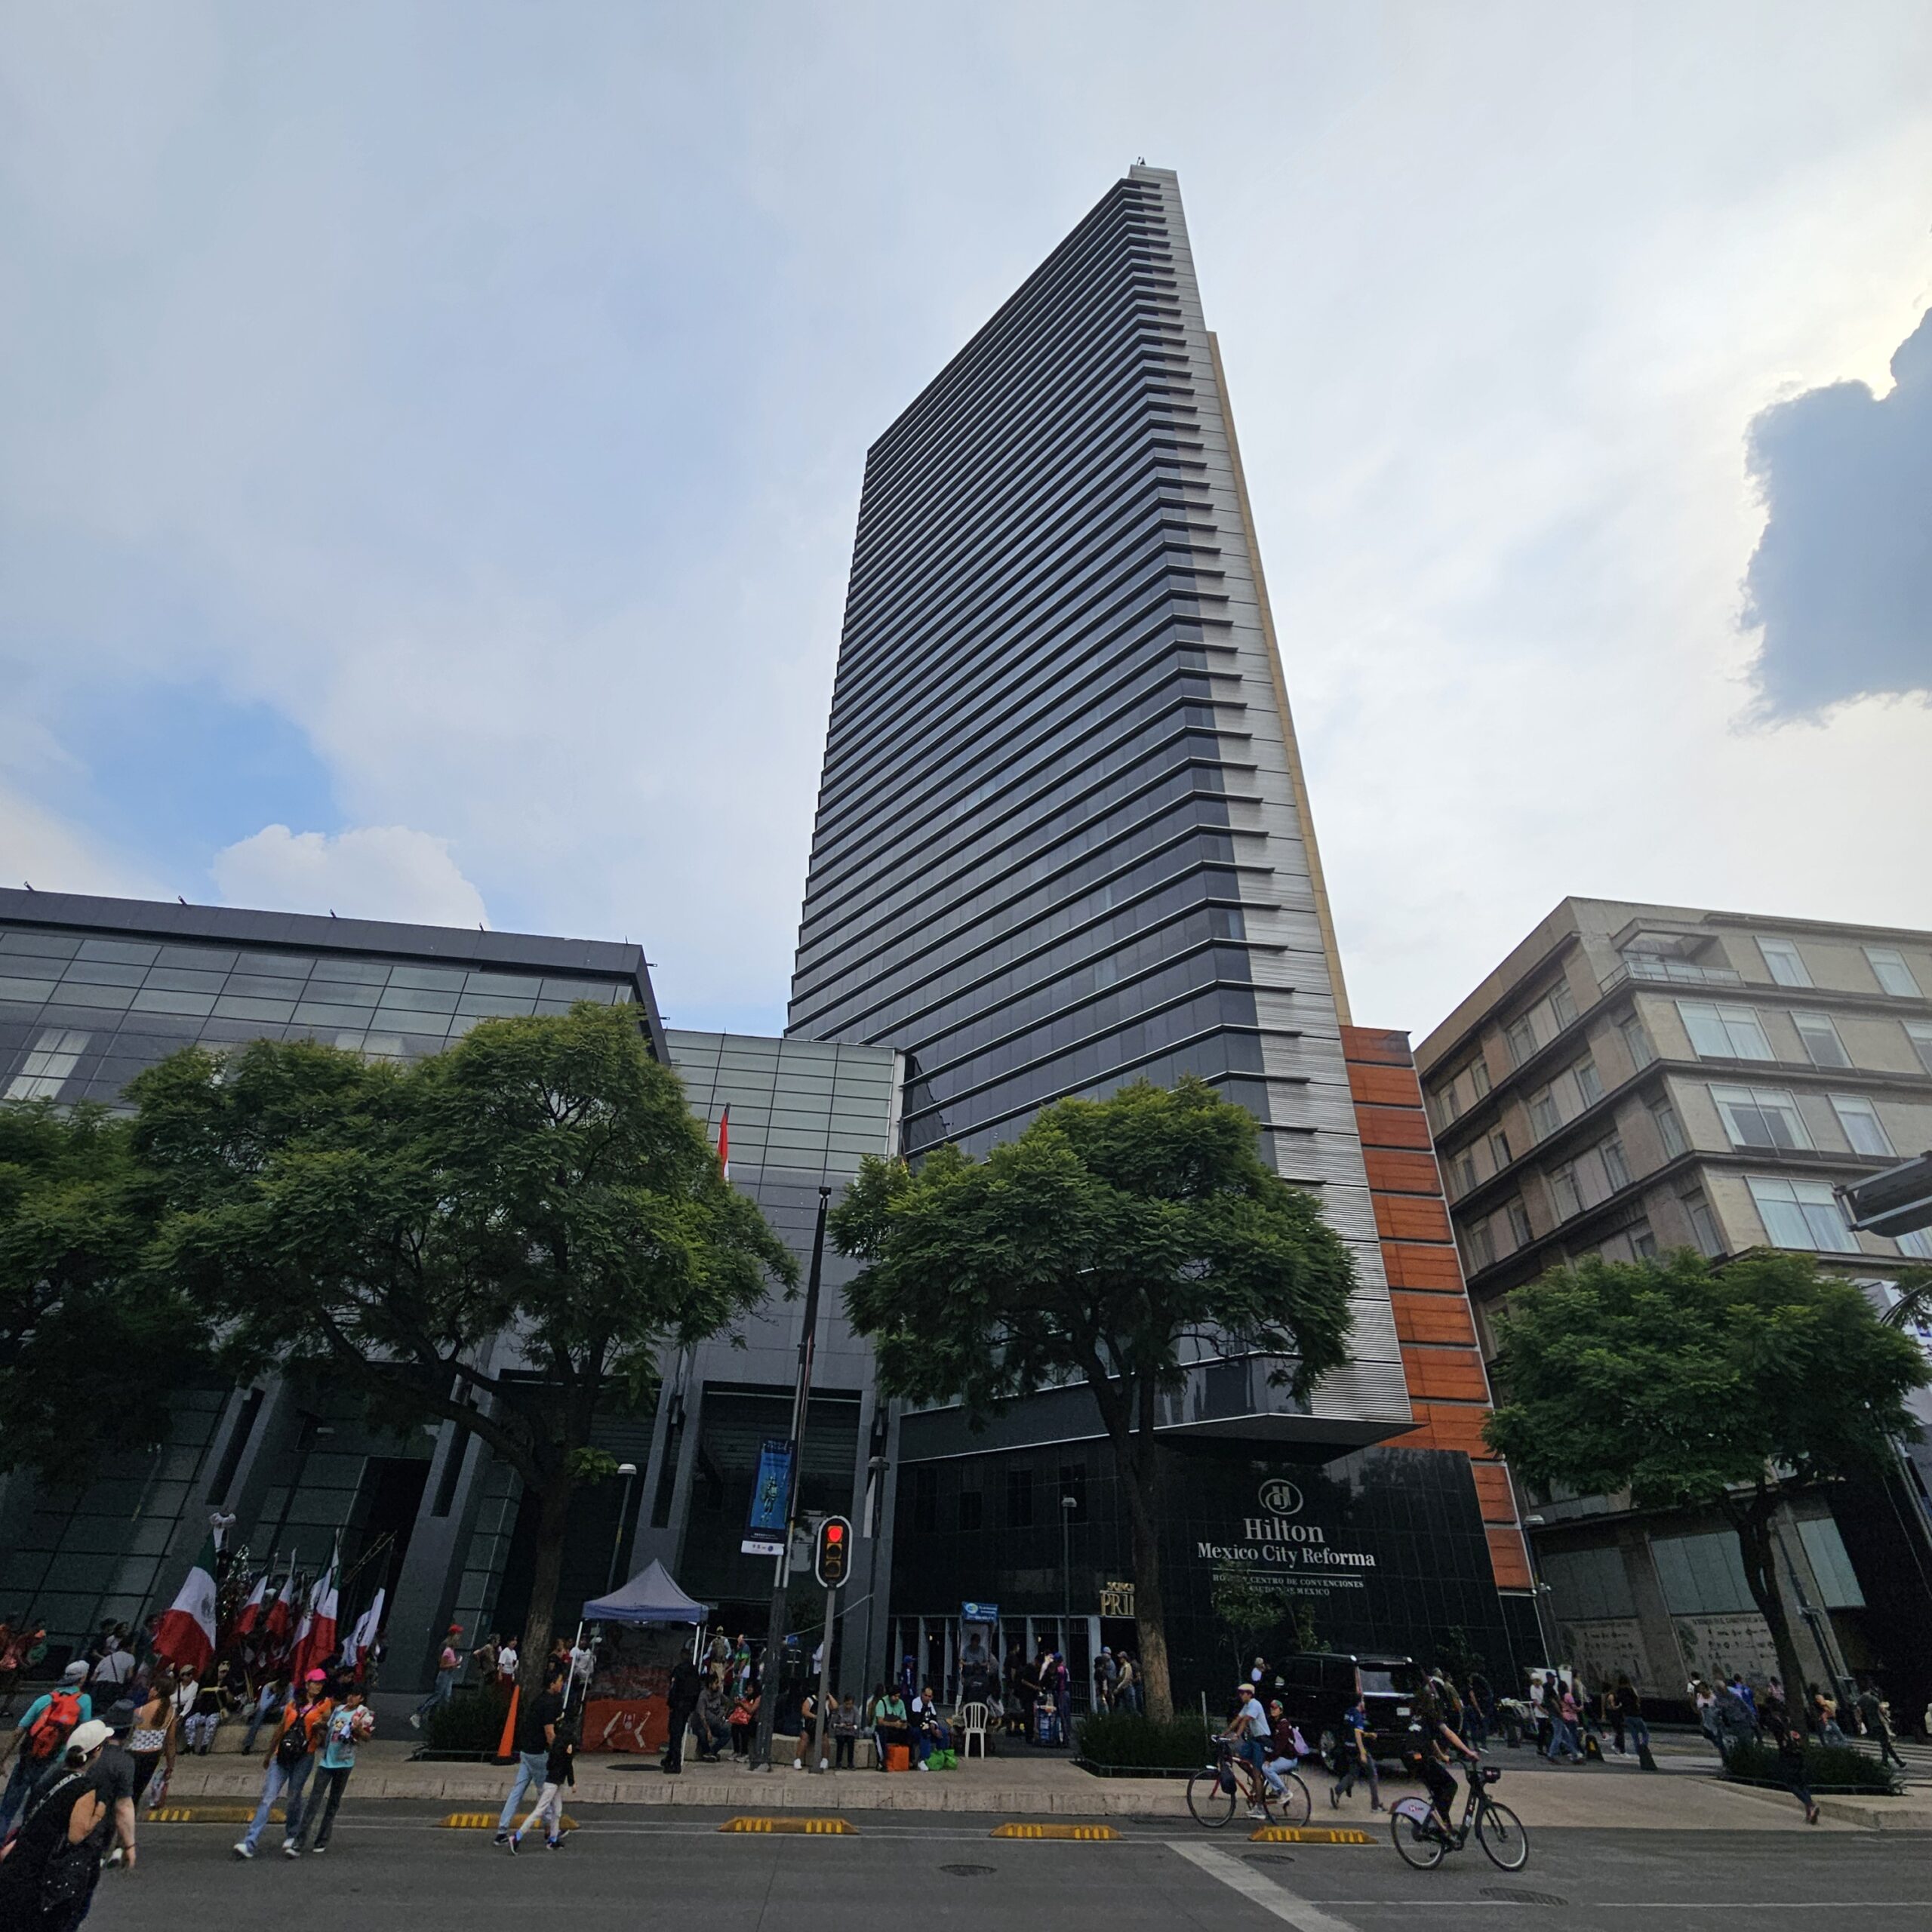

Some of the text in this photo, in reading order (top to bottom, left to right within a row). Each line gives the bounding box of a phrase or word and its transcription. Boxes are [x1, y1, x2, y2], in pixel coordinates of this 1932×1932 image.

[1243, 1516, 1325, 1543] Hilton
[1197, 1542, 1377, 1568] Mexico City Reforma
[1287, 1577, 1298, 1586] DE
[1300, 1578, 1364, 1589] CONVENCIONES
[1297, 1587, 1331, 1596] MEXICO
[1100, 1593, 1134, 1616] PRI
